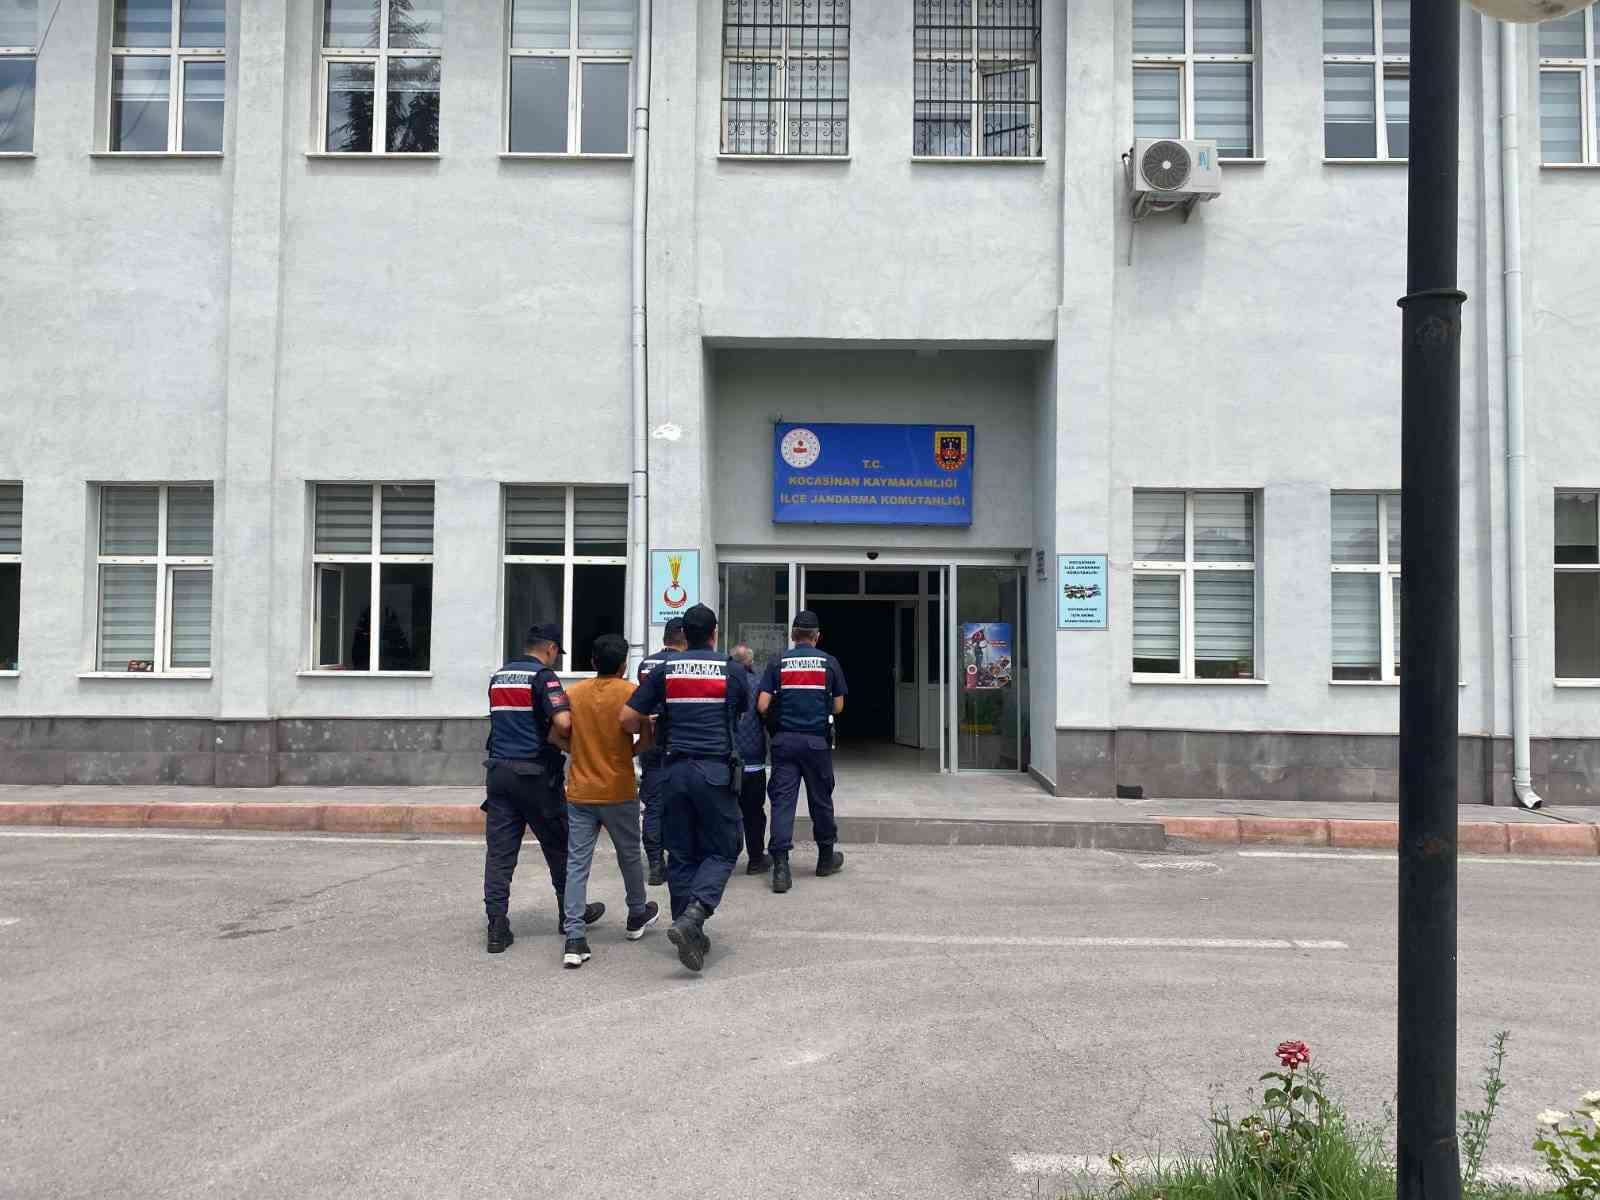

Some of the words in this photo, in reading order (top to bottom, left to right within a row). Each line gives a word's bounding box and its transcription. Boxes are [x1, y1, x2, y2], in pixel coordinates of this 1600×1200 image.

[788, 475, 860, 487] KOCASİNAN
[863, 476, 957, 489] KAYMAKAMLIĞI
[811, 495, 878, 505] JANDARMA
[880, 495, 965, 506] KOMUTANLIĞI
[671, 663, 721, 676] JANDARMA
[785, 659, 822, 669] JANDARMA
